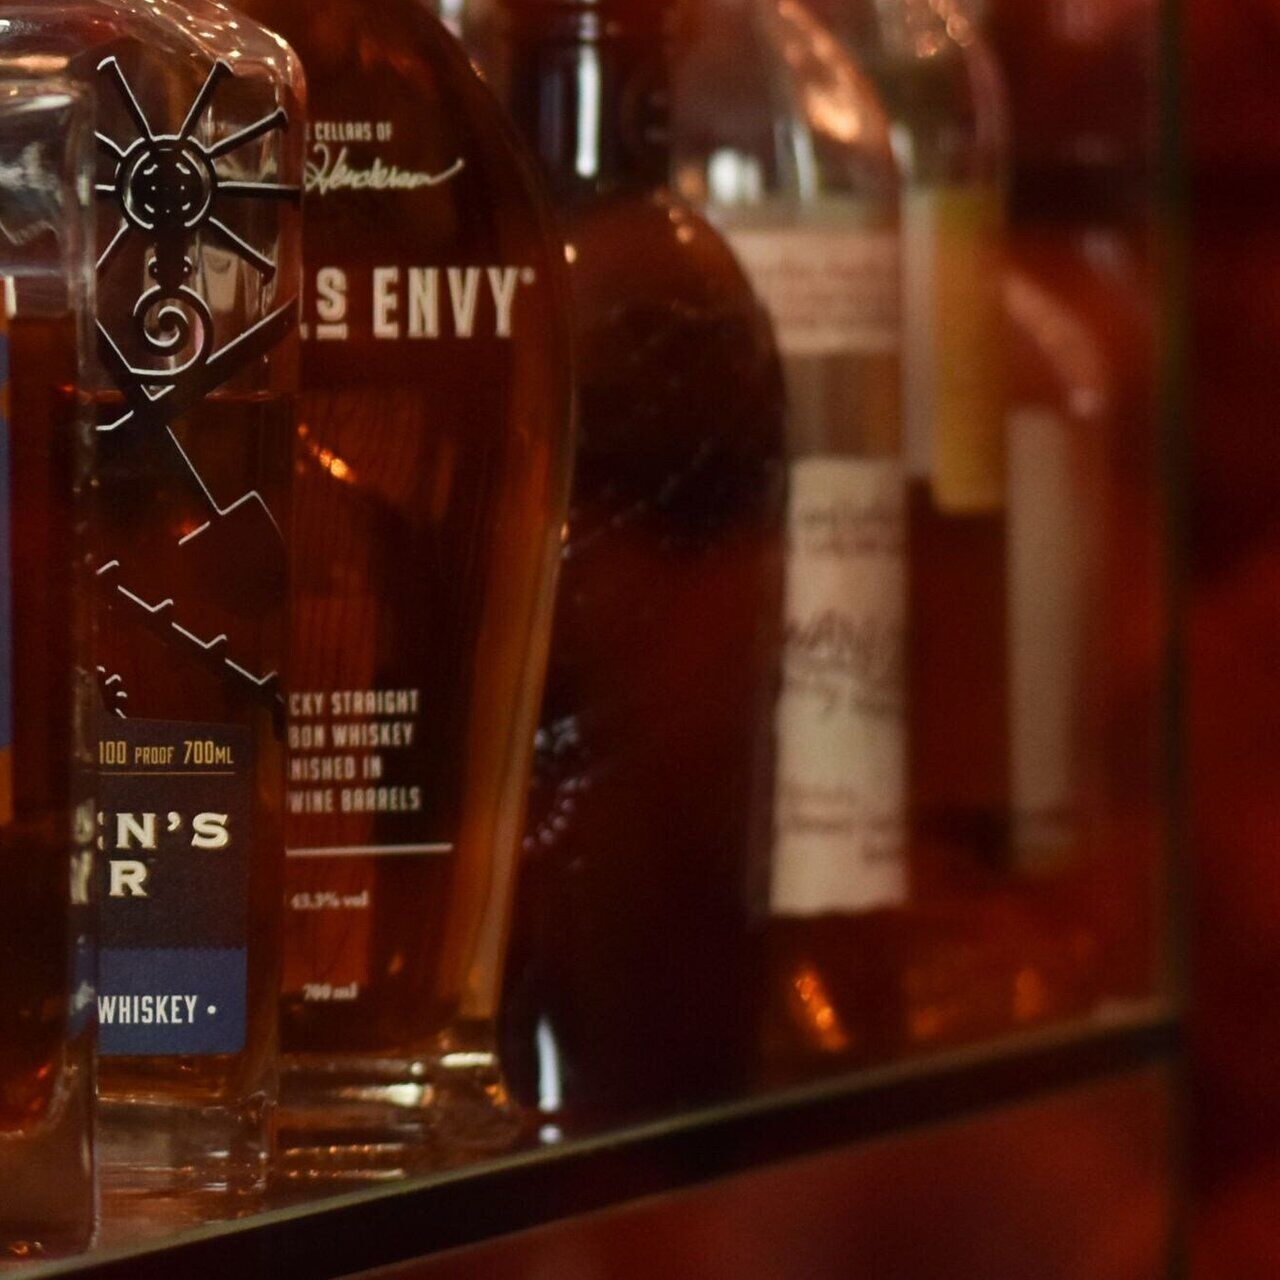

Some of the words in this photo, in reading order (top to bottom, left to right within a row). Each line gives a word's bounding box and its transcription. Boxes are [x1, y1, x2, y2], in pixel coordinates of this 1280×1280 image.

[330, 688, 419, 715] STRAIGHT
[331, 721, 413, 747] WHISKEY
[98, 740, 127, 764] 100
[134, 746, 175, 765] PROOF
[183, 740, 235, 765] 700ML
[97, 994, 198, 1025] WHISKEY
